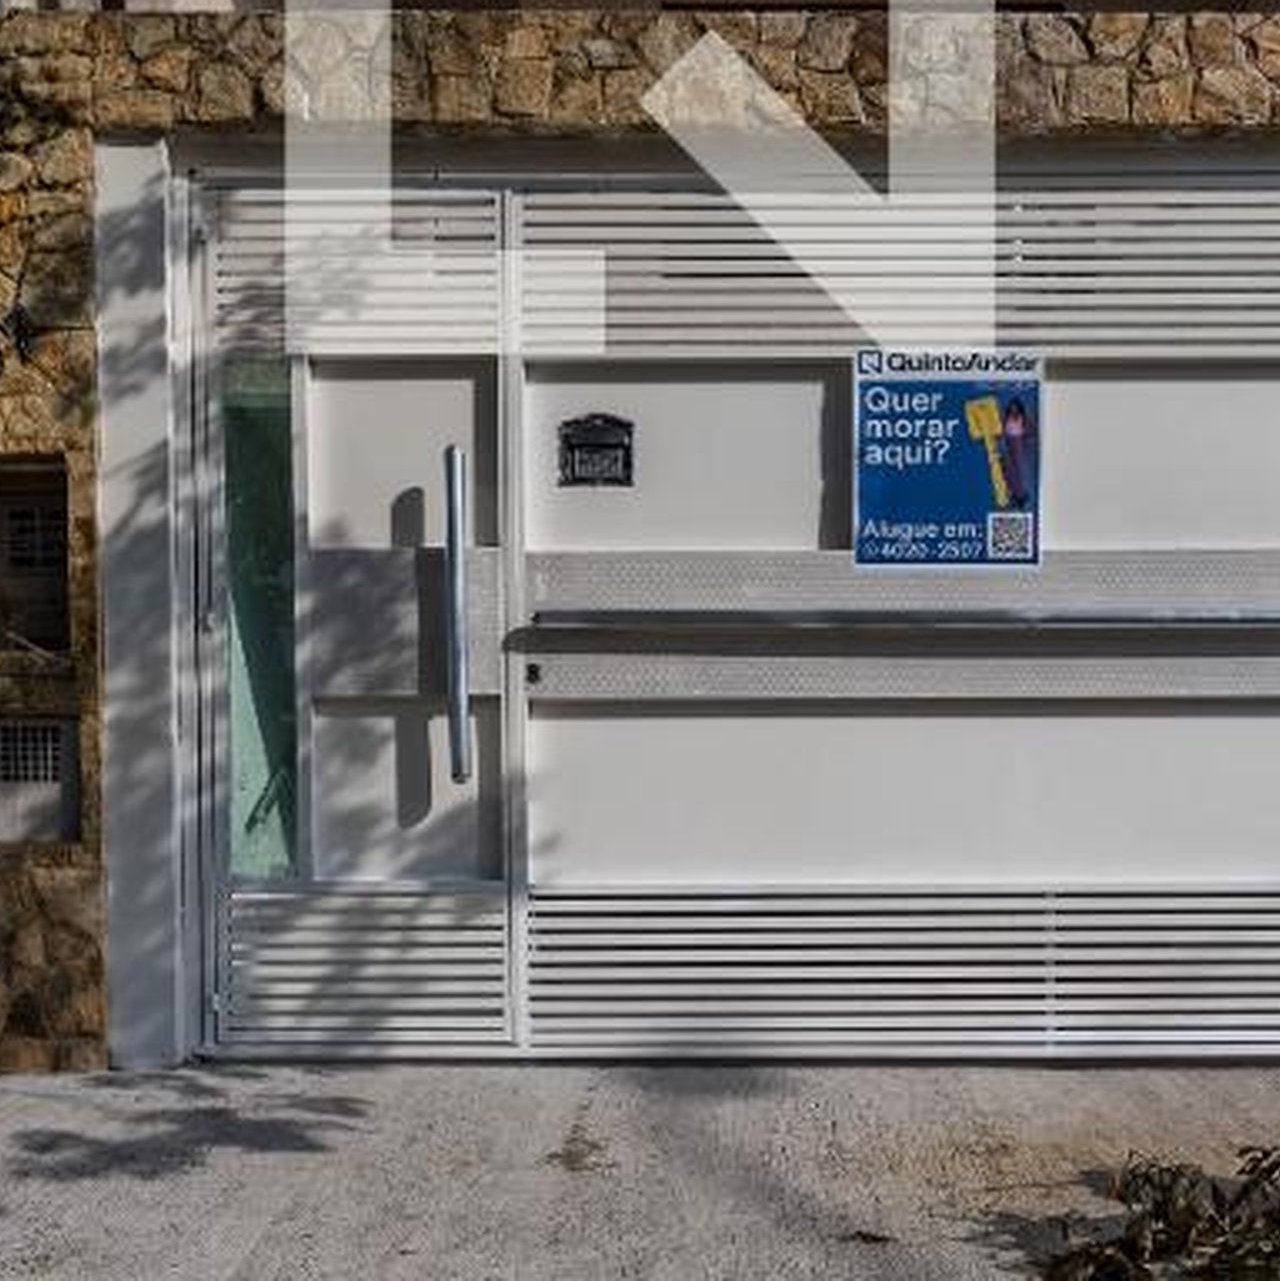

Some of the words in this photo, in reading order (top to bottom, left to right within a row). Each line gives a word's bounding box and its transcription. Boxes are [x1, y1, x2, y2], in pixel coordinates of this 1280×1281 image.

[886, 352, 1038, 372] QuintoAndar
[865, 386, 943, 412] Quer
[864, 418, 960, 438] morar
[863, 439, 951, 469] aqui?
[862, 519, 940, 543] Alugue
[943, 522, 984, 539] em:
